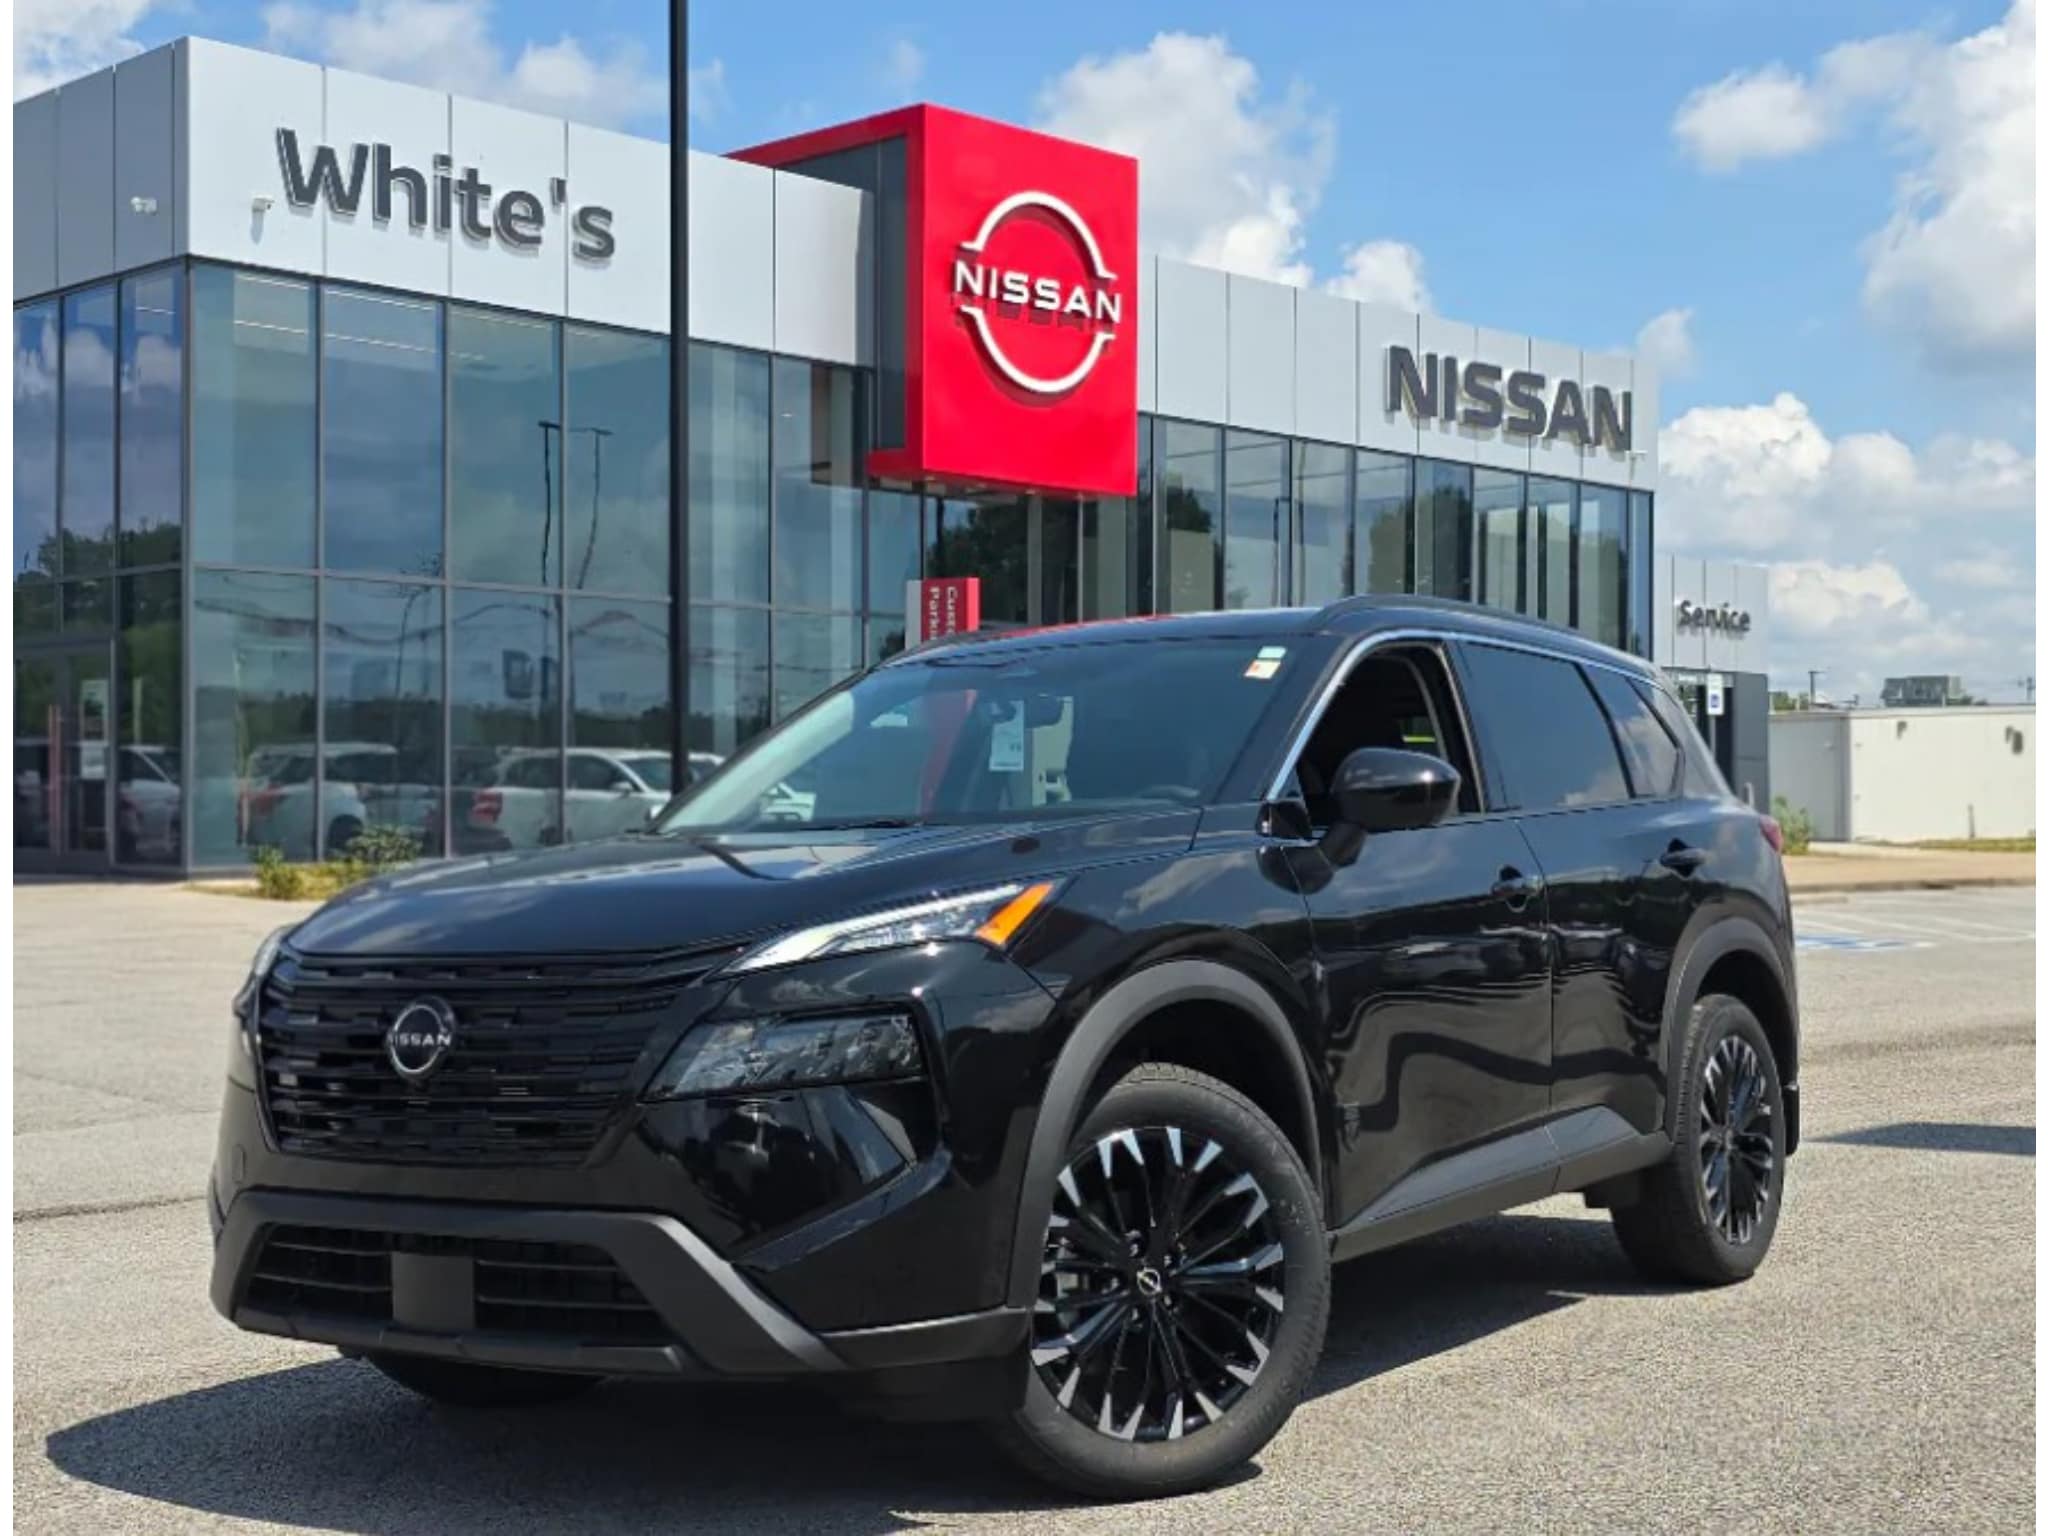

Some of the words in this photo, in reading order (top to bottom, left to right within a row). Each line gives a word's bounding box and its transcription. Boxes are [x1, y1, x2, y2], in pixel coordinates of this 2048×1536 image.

[276, 127, 616, 260] White's
[953, 260, 1122, 325] NISSAN
[1385, 344, 1633, 452] NISSAN
[1677, 600, 1751, 634] Service
